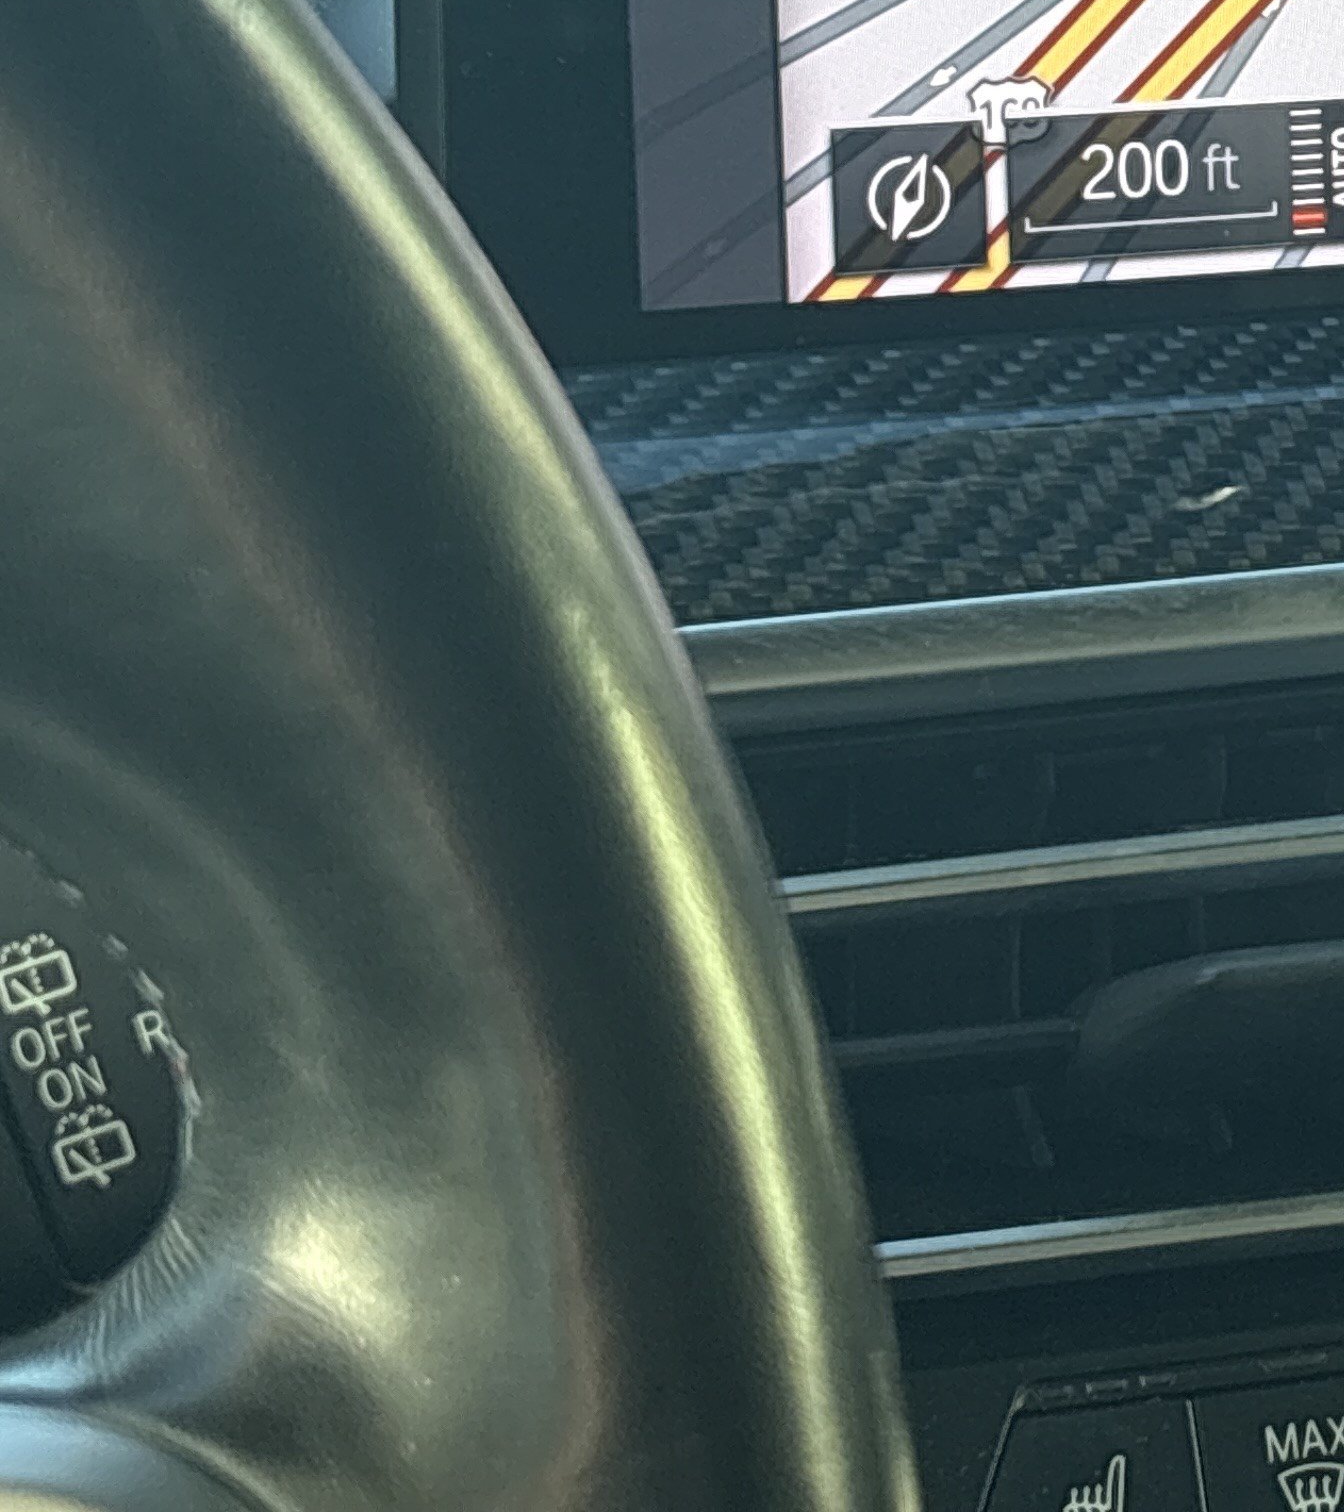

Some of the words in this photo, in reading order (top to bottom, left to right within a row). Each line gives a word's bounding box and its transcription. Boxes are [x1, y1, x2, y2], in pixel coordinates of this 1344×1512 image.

[1081, 139, 1189, 200] 200
[1202, 143, 1241, 191] ft
[11, 1008, 92, 1070] OFF
[38, 1055, 106, 1111] ON
